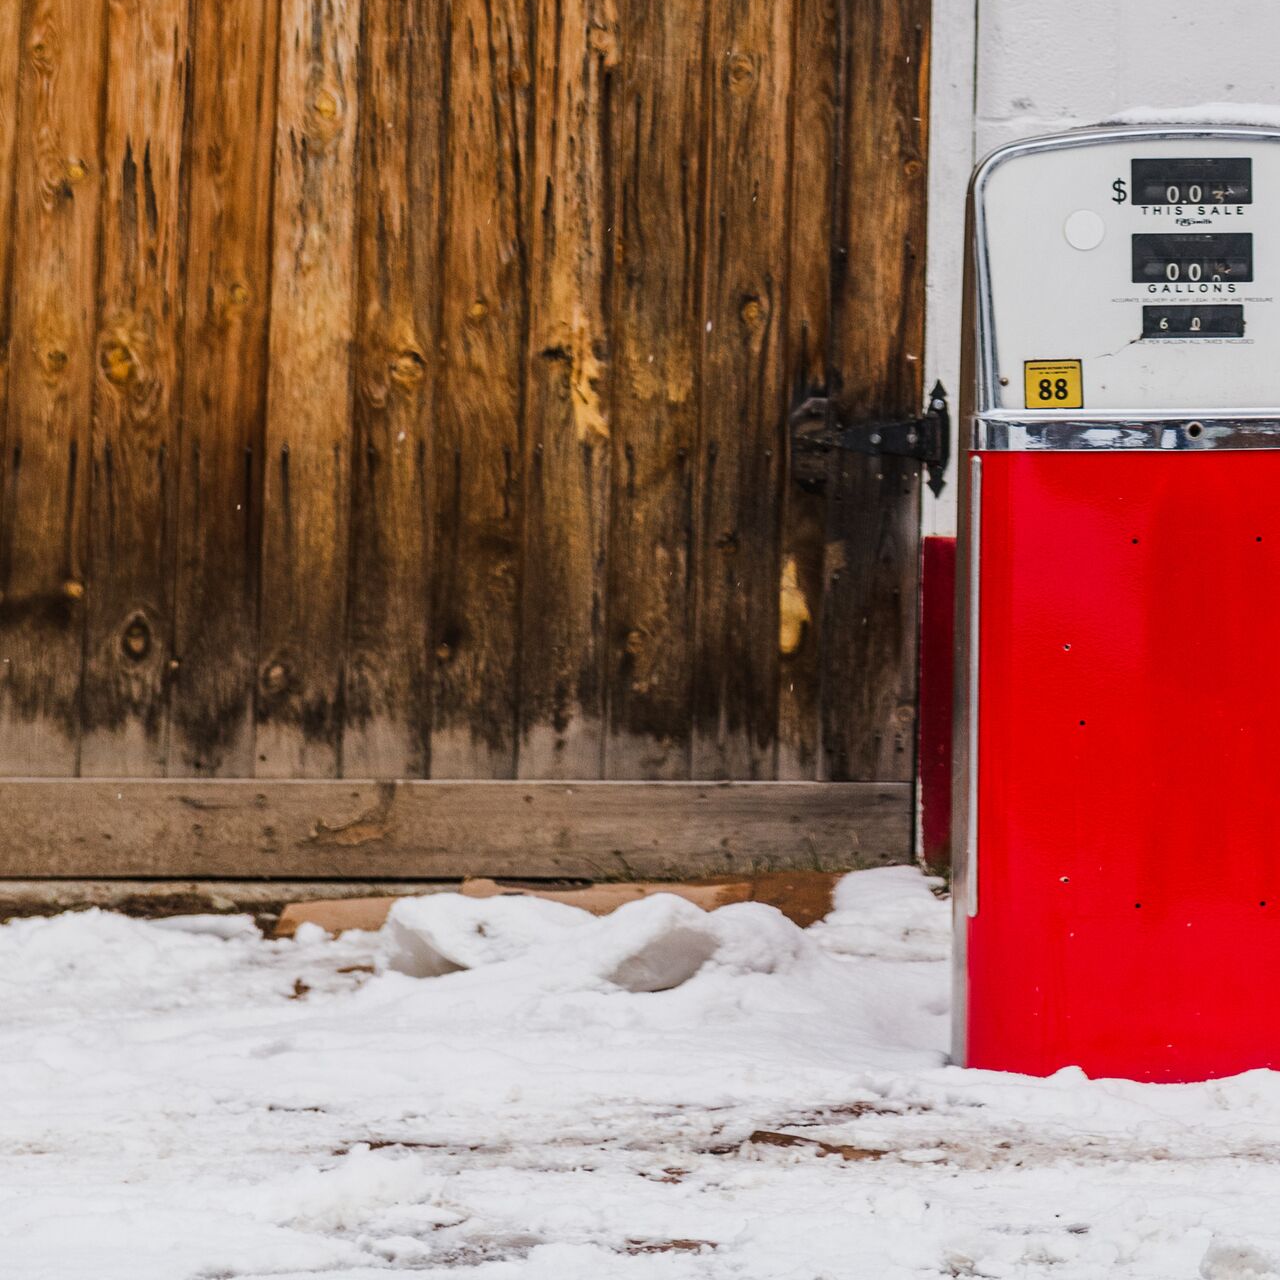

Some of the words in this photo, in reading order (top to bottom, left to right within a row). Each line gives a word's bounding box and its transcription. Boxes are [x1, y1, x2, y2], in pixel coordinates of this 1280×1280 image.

[1140, 206, 1183, 216] THIS
[1197, 205, 1245, 215] SALE
[1147, 283, 1237, 294] GALLONS
[1039, 378, 1069, 401] 88
